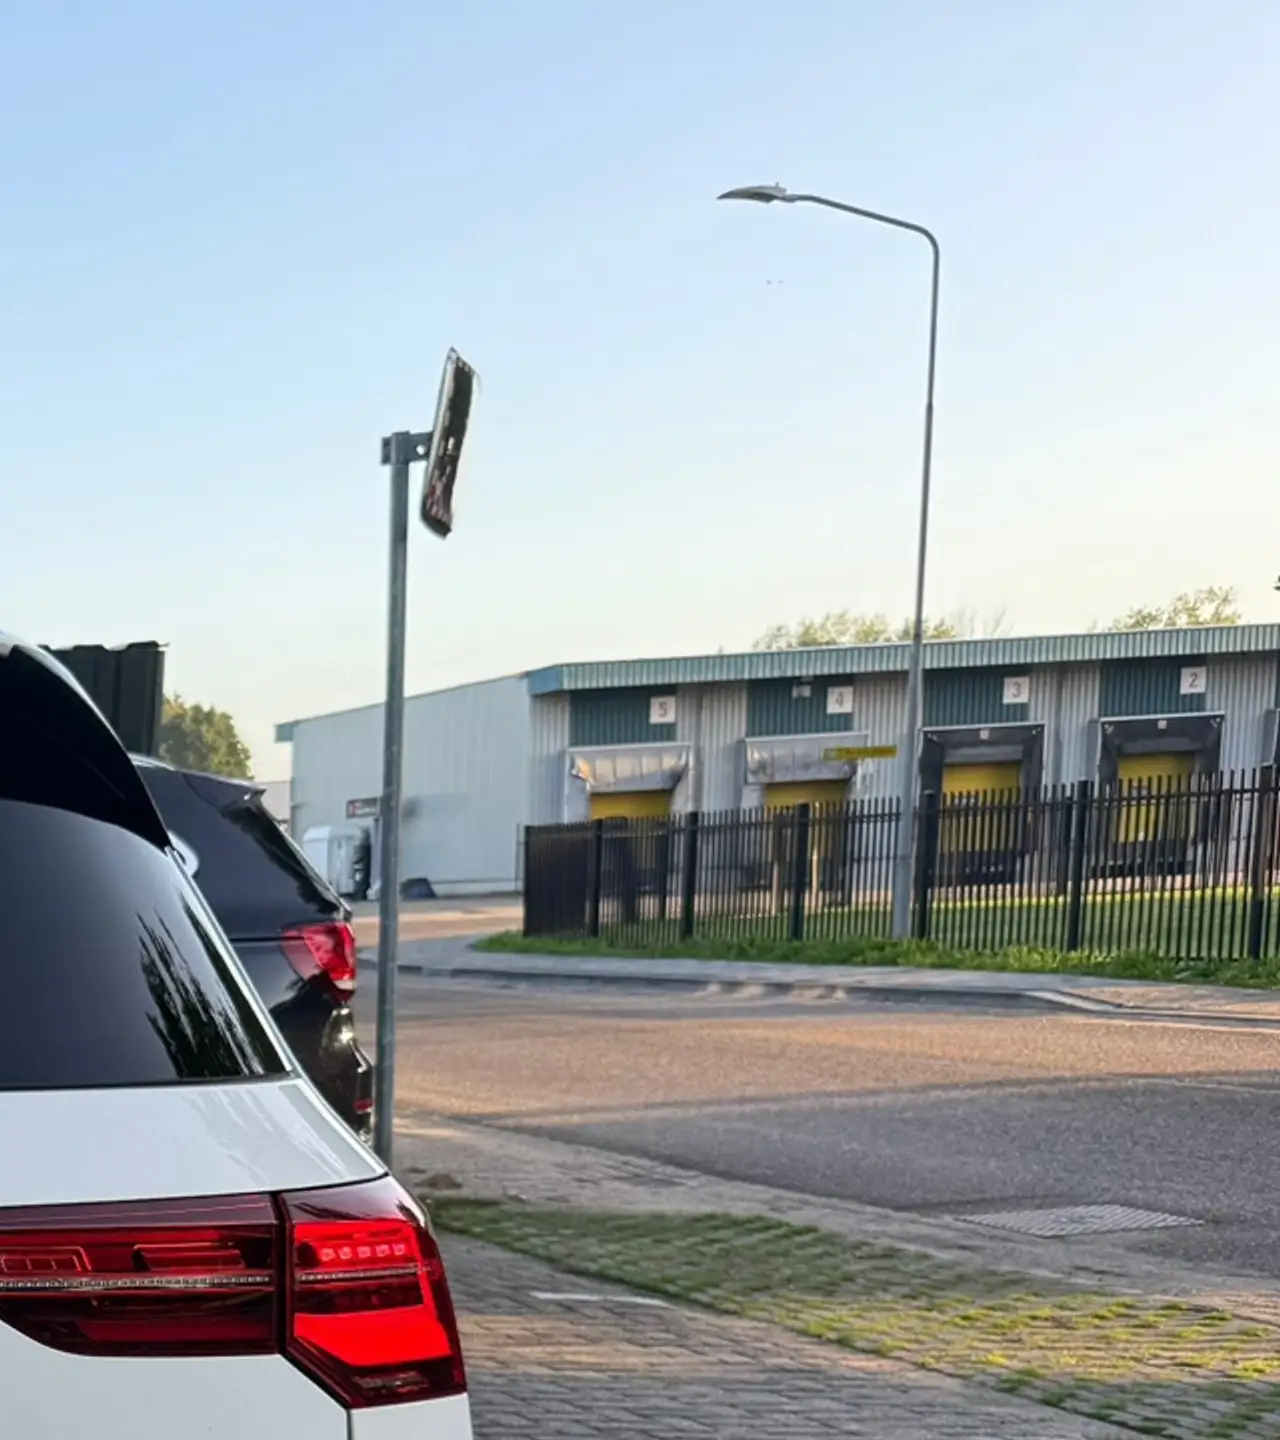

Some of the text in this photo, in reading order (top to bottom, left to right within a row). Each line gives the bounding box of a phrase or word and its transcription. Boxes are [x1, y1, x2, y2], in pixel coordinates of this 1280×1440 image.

[1188, 671, 1200, 689] 2
[1011, 681, 1023, 698] 3
[834, 691, 845, 708] 4
[658, 701, 670, 718] 5
